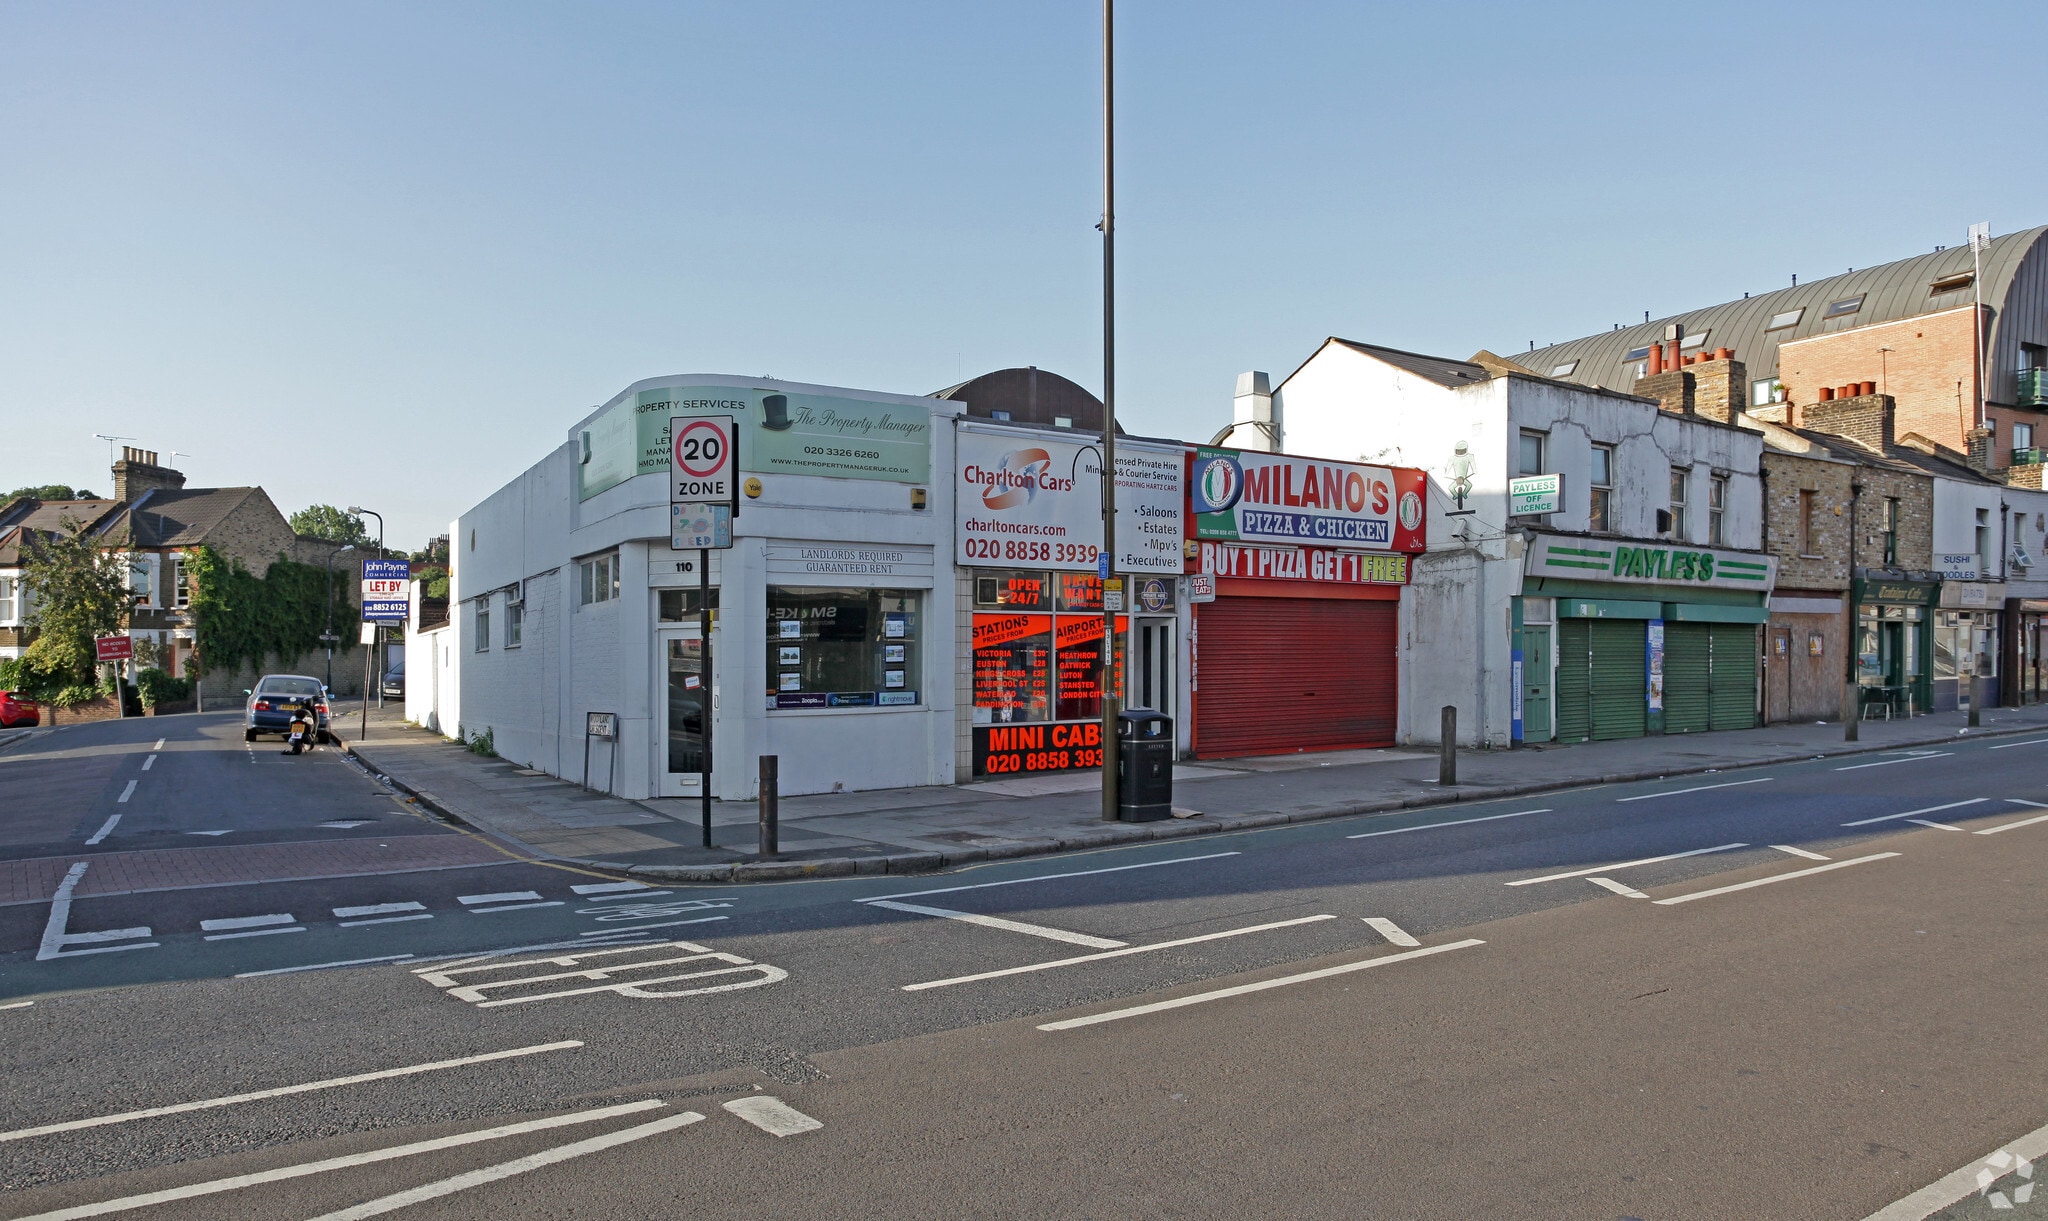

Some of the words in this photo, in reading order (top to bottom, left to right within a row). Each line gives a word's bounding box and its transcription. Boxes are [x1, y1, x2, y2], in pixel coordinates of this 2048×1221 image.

[633, 401, 680, 414] PROPERTY
[683, 400, 746, 410] SERVICES
[792, 406, 815, 425] The
[819, 409, 872, 434] Property
[874, 414, 926, 437] Manager
[646, 447, 671, 456] MANA
[684, 438, 720, 460] 20
[804, 446, 824, 454] 020
[826, 448, 852, 457] 3326
[854, 450, 880, 459] 6260
[638, 459, 654, 468] HMO
[770, 458, 910, 474] WWW.THEPROPERTYMANAGERUK.CO.UK
[1115, 458, 1136, 466] ensed
[1138, 458, 1162, 468] Private
[1163, 461, 1178, 470] Hire
[964, 465, 1034, 490] Charlton
[1038, 472, 1072, 492] Cars
[1118, 468, 1124, 476] &
[1126, 468, 1152, 479] Courier
[1152, 471, 1178, 482] Service
[679, 482, 724, 496] ZONE
[1115, 480, 1145, 488] RPORATING
[1244, 464, 1390, 516] MILANO'S
[1514, 481, 1556, 492] PAYLESS
[1140, 505, 1178, 519] Saloons
[1516, 503, 1552, 512] LICENCE
[965, 518, 1066, 536] charltoncars.com
[1144, 522, 1178, 535] Estates
[1245, 512, 1294, 534] PIZZA
[1298, 516, 1310, 536] &
[1314, 518, 1386, 540] CHICKEN
[966, 538, 1000, 559] 020
[1006, 540, 1050, 561] 8858
[1056, 543, 1098, 564] 3939
[1150, 540, 1178, 552] Mpv's
[801, 549, 856, 560] LANDLORDS
[858, 552, 903, 562] REQUIRED
[1126, 554, 1178, 568] Executives
[366, 562, 382, 572] John
[384, 562, 408, 572] Payne
[676, 562, 692, 572] 110
[806, 562, 867, 573] GUARANTEED
[870, 564, 893, 574] RENT
[1202, 543, 1239, 576] BUY
[1244, 548, 1253, 576] 1
[1258, 549, 1306, 578] PIZZA
[1311, 550, 1345, 580] GET
[1349, 555, 1357, 582] 1
[1362, 556, 1407, 583] FREE
[1614, 546, 1714, 581] PAYLESS
[370, 582, 386, 592] LET
[390, 582, 402, 592] BY
[1008, 578, 1040, 590] OPEN
[1062, 574, 1102, 588] DRIVE
[1192, 578, 1208, 587] JUST
[1010, 592, 1039, 604] 24/7
[1064, 588, 1102, 600] WANT
[972, 616, 1028, 638] STATIONS
[1056, 618, 1104, 638] AIRPORT
[982, 634, 1006, 644] PRICES
[1006, 629, 1024, 638] FROM
[1066, 632, 1086, 642] PRICES
[989, 726, 1044, 752] MINI
[1052, 724, 1103, 748] CAB
[986, 754, 1020, 774] 020
[1026, 751, 1069, 770] 8858
[1074, 749, 1103, 768] 393
